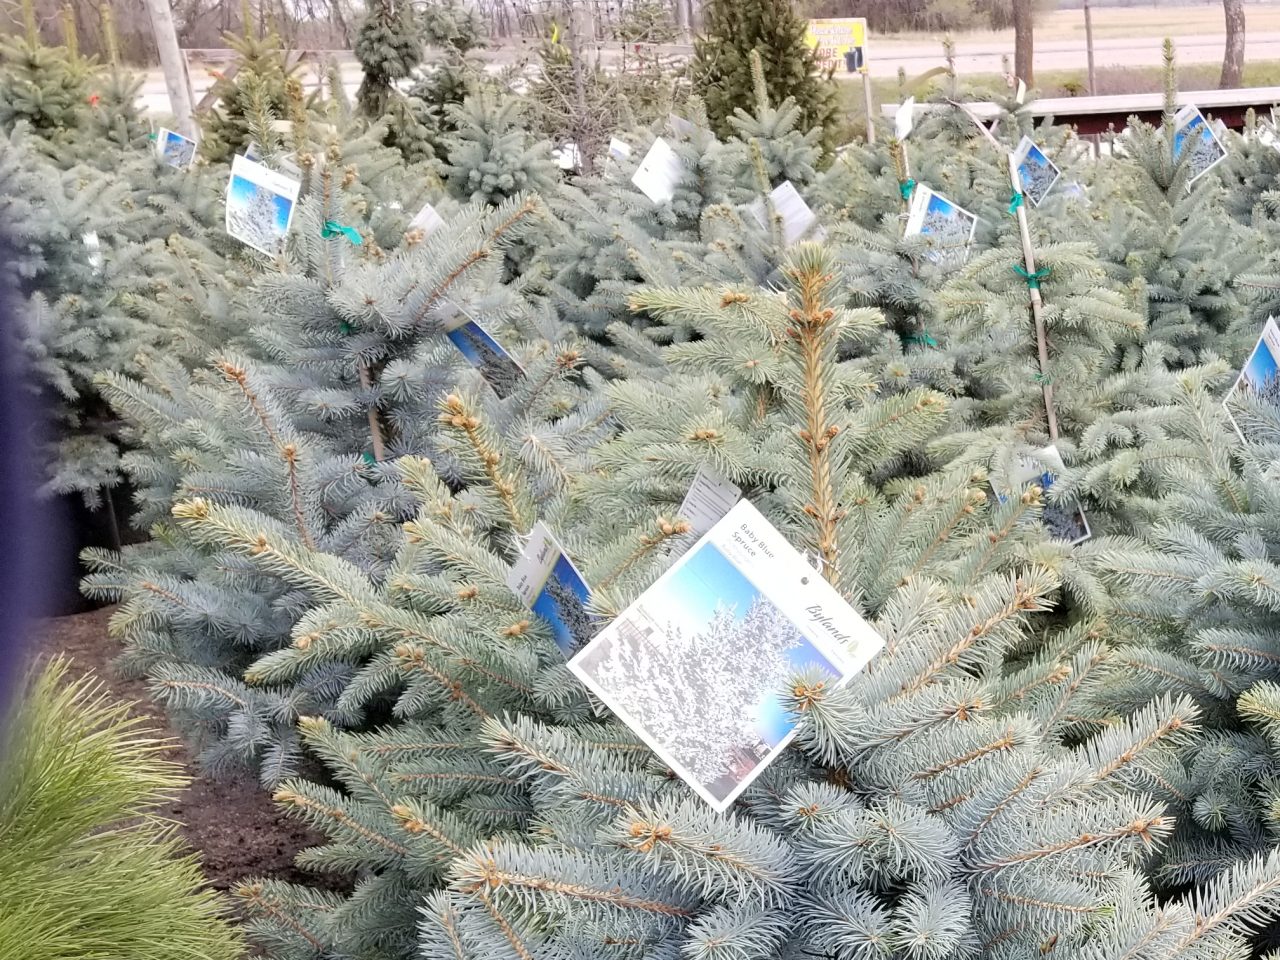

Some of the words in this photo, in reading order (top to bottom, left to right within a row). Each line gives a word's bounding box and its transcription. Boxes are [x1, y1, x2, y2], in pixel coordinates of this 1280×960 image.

[731, 531, 757, 557] Spruce
[740, 523, 758, 544] Baby
[758, 541, 775, 559] Blue
[805, 604, 852, 645] Bylands
